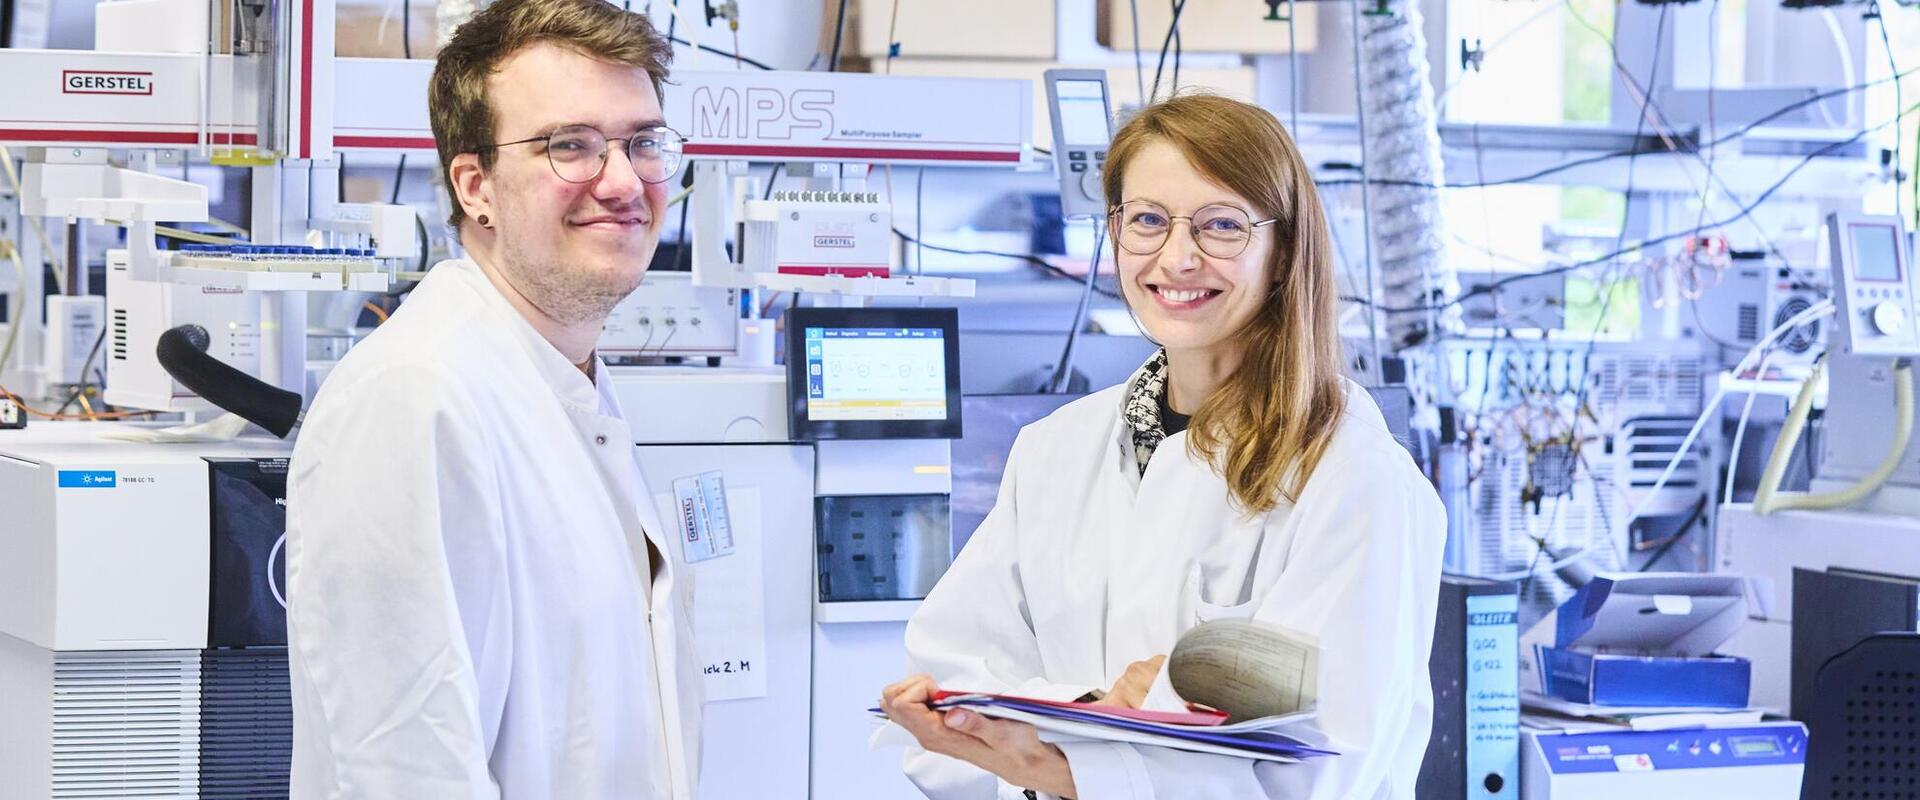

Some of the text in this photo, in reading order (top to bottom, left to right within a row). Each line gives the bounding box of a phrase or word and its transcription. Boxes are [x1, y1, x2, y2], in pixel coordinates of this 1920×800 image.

[69, 76, 146, 90] GERSTEL
[691, 86, 835, 140] MPS
[892, 130, 923, 139] Sampler
[816, 238, 852, 246] GERSTEL
[684, 502, 696, 539] GERSTEL
[740, 660, 751, 671] M
